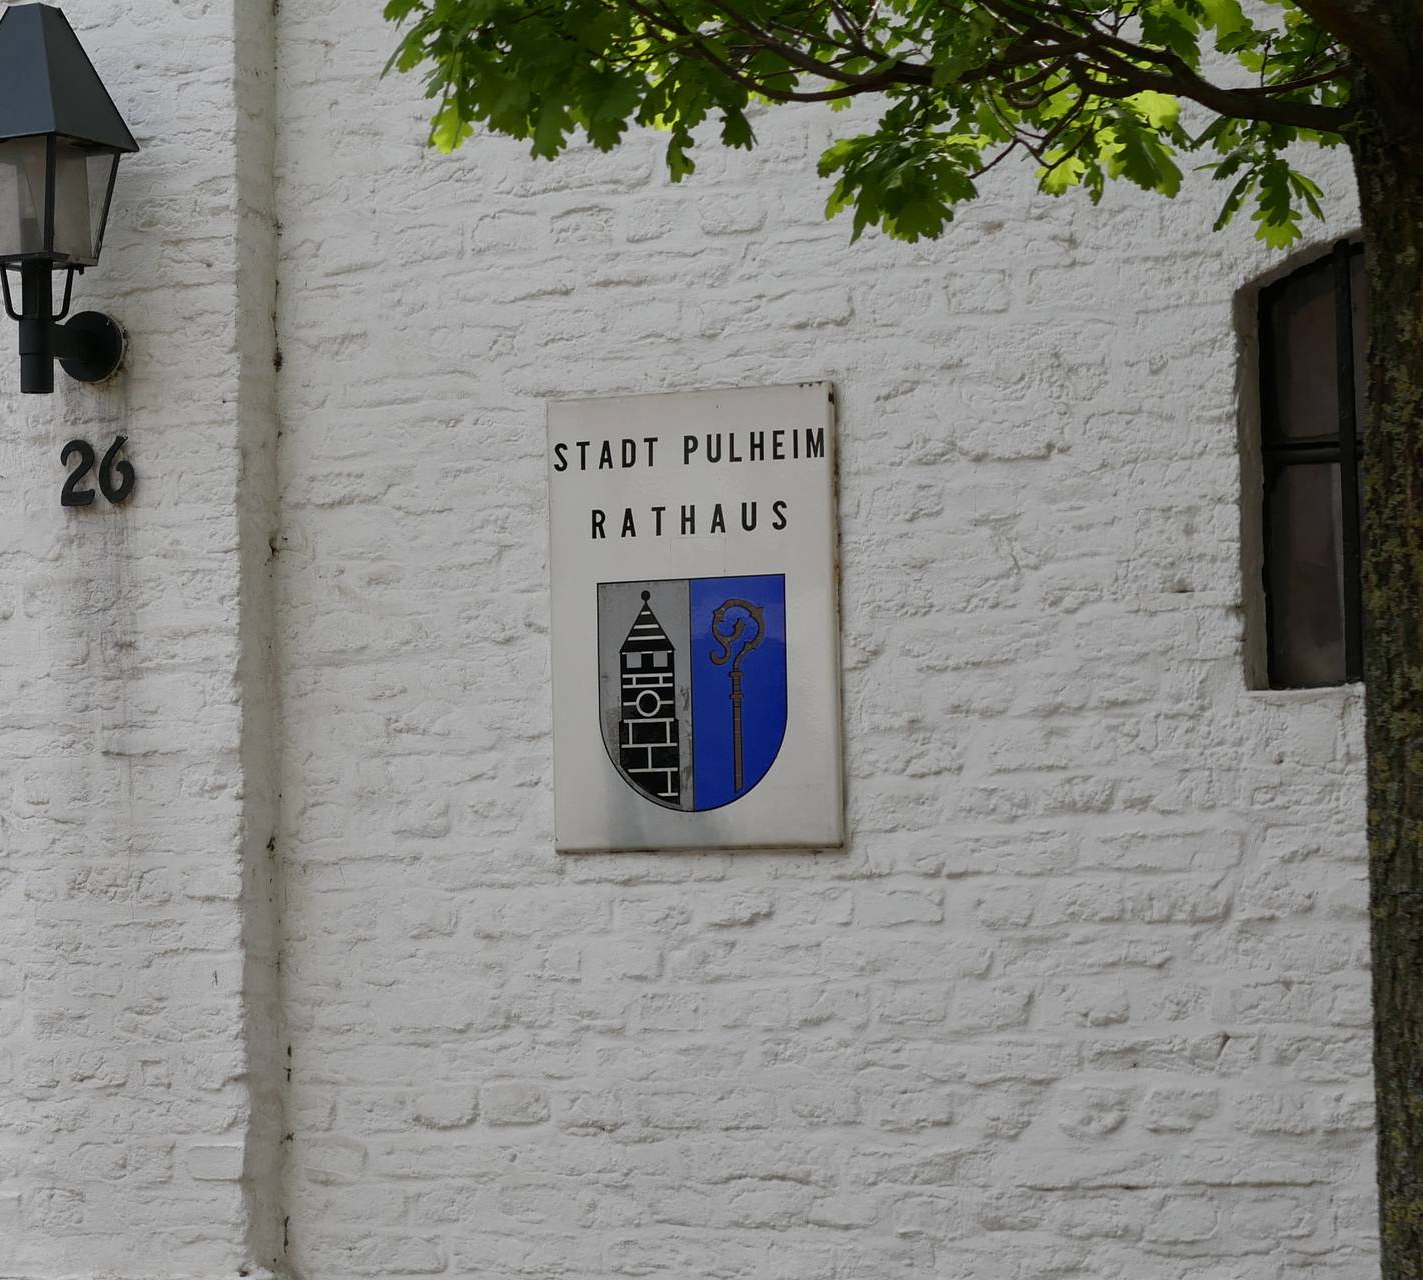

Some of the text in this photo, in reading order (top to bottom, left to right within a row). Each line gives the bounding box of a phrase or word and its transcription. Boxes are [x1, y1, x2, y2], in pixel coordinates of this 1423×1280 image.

[60, 435, 135, 506] 26
[554, 428, 826, 472] STADT PULHEIM
[591, 500, 788, 539] RATHAUS
